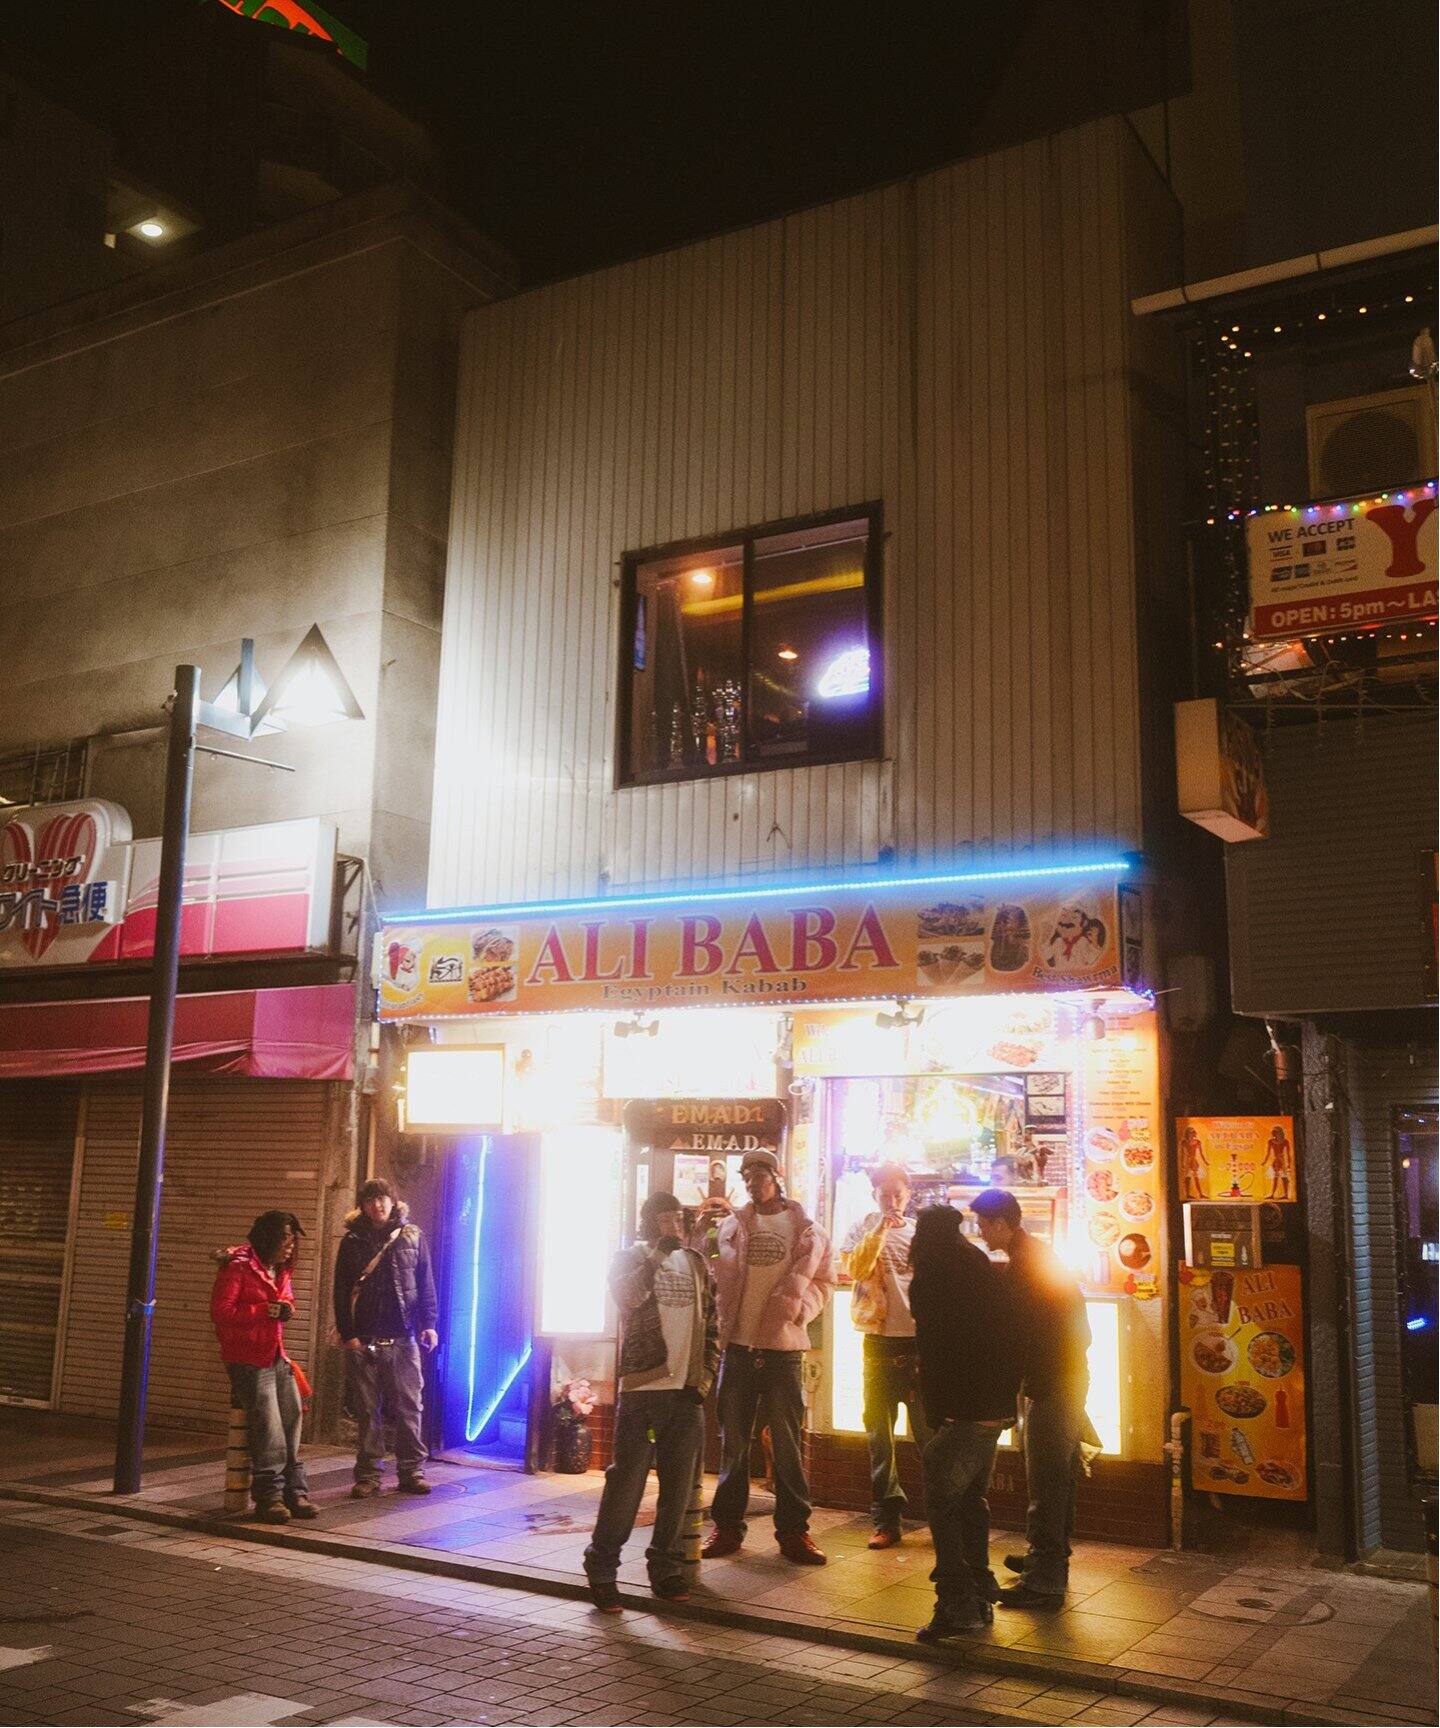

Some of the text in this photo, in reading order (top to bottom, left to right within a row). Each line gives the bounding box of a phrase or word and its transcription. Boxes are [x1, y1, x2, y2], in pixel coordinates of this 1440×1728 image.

[1268, 518, 1357, 543] WE ACCEPT
[525, 902, 900, 986] ALI BABA
[603, 976, 807, 1000] Egyptain Kabab
[692, 1133, 760, 1151] EMAD
[1241, 1272, 1277, 1296] ALI
[1238, 1299, 1295, 1325] BABA
